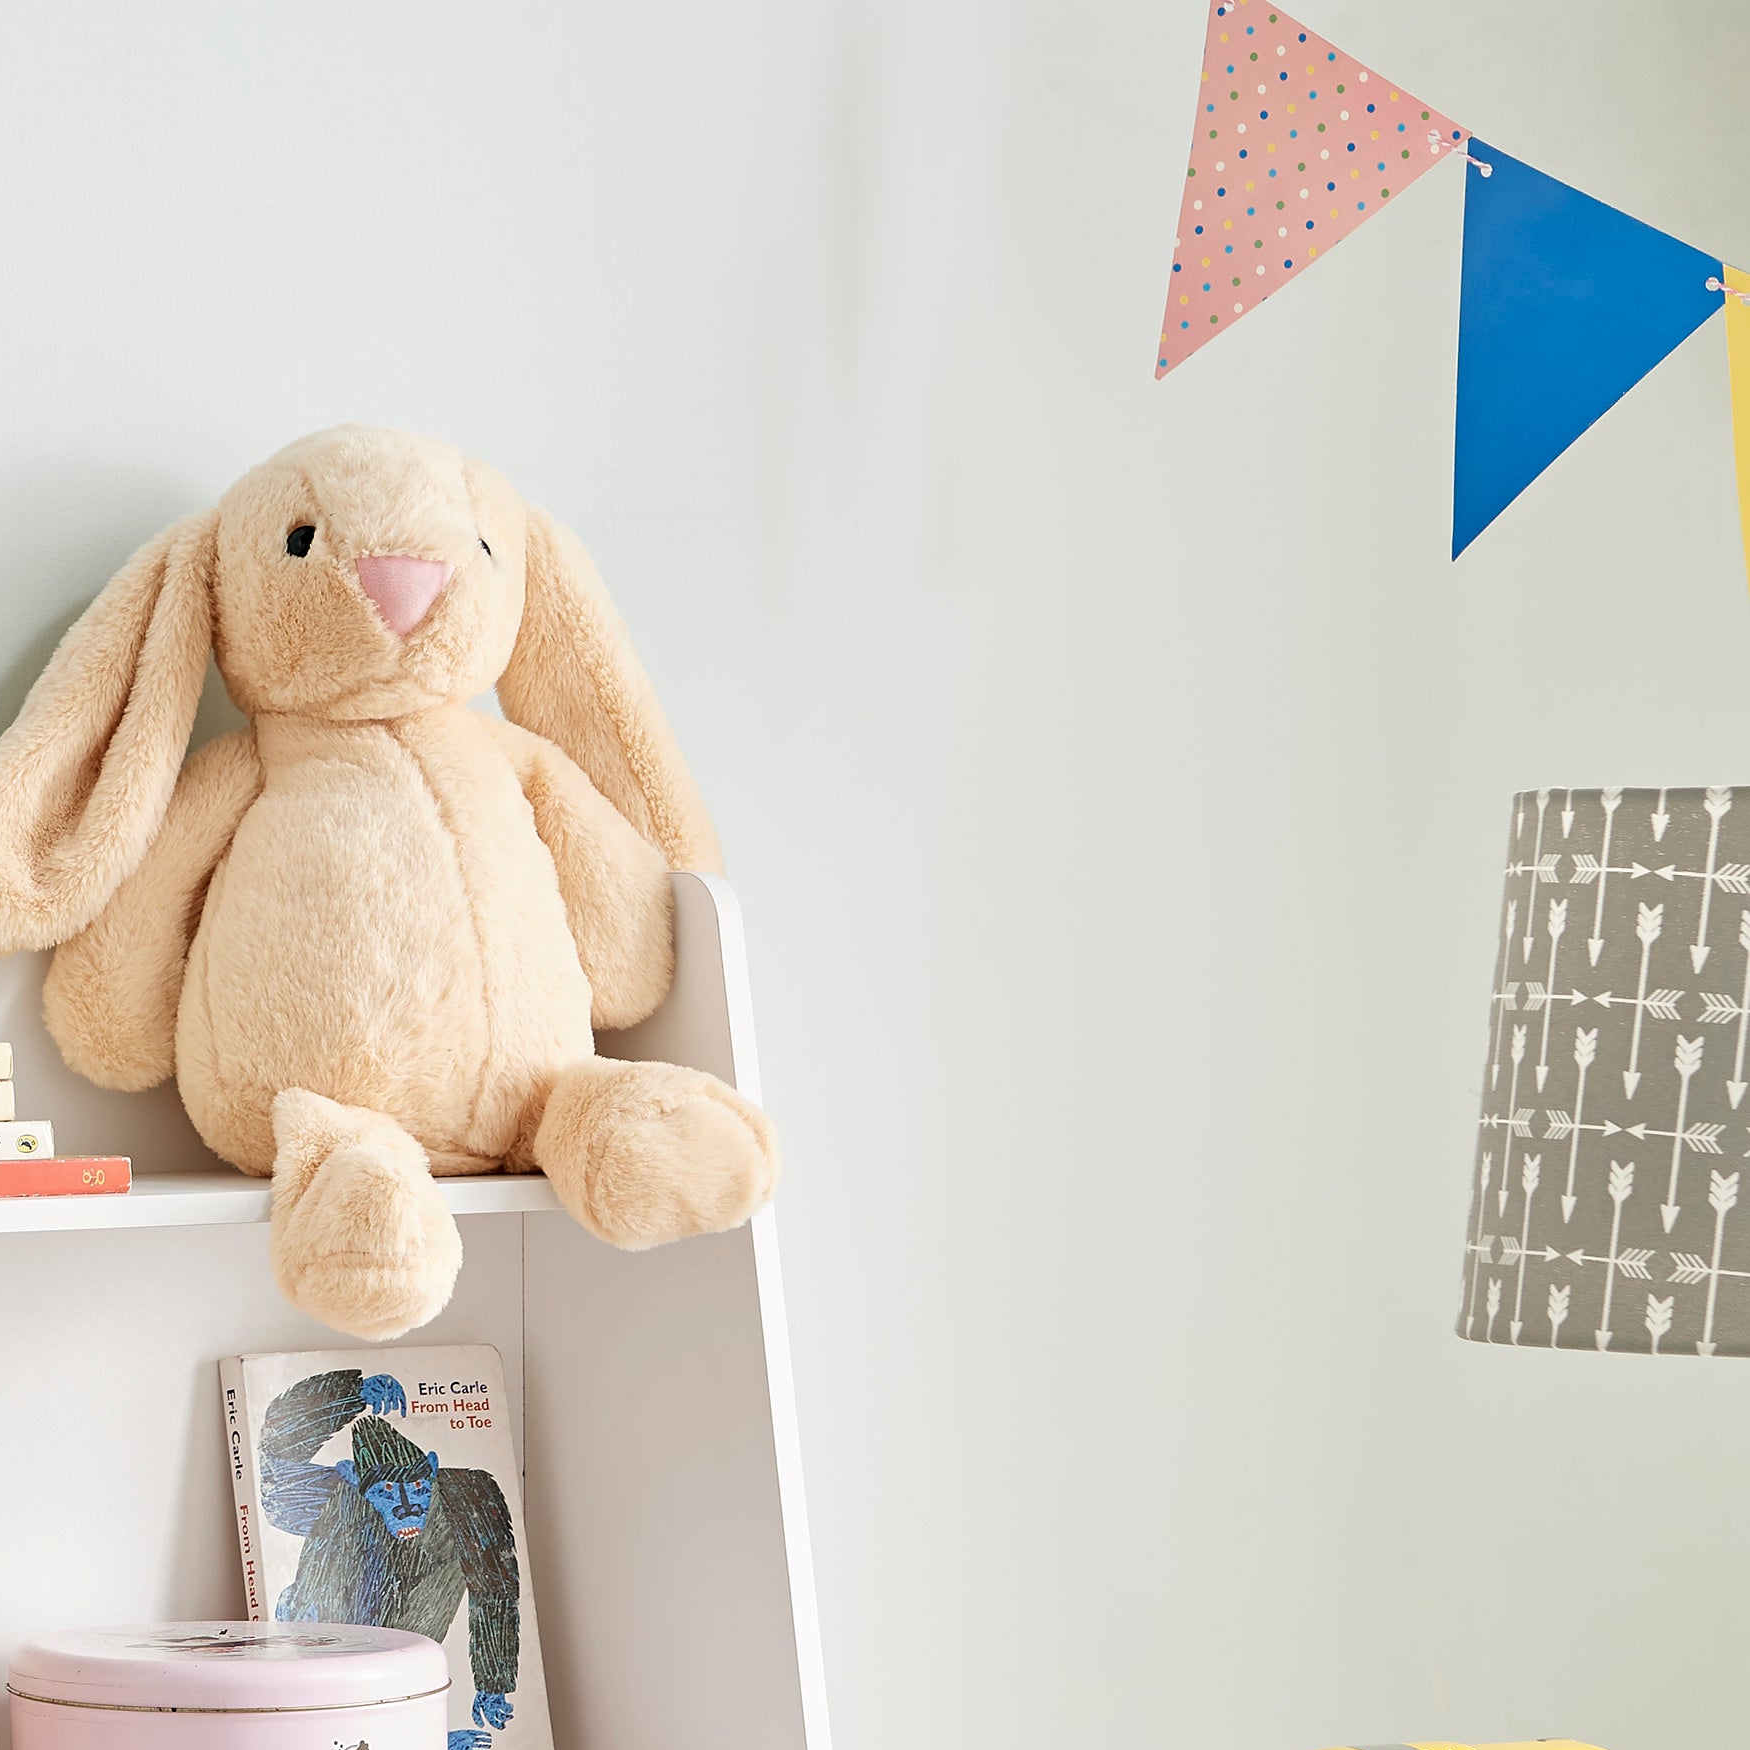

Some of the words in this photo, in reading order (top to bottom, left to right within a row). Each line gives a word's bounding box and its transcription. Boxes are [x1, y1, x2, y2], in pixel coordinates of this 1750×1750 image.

[226, 1388, 237, 1425] Eric
[411, 1401, 449, 1413] From
[453, 1398, 490, 1412] Head
[418, 1382, 446, 1396] Eric
[450, 1380, 488, 1394] Carle
[449, 1419, 465, 1430] to
[466, 1415, 492, 1428] Toe
[231, 1430, 243, 1481] Carle
[239, 1504, 251, 1554] From
[246, 1560, 259, 1609] Head
